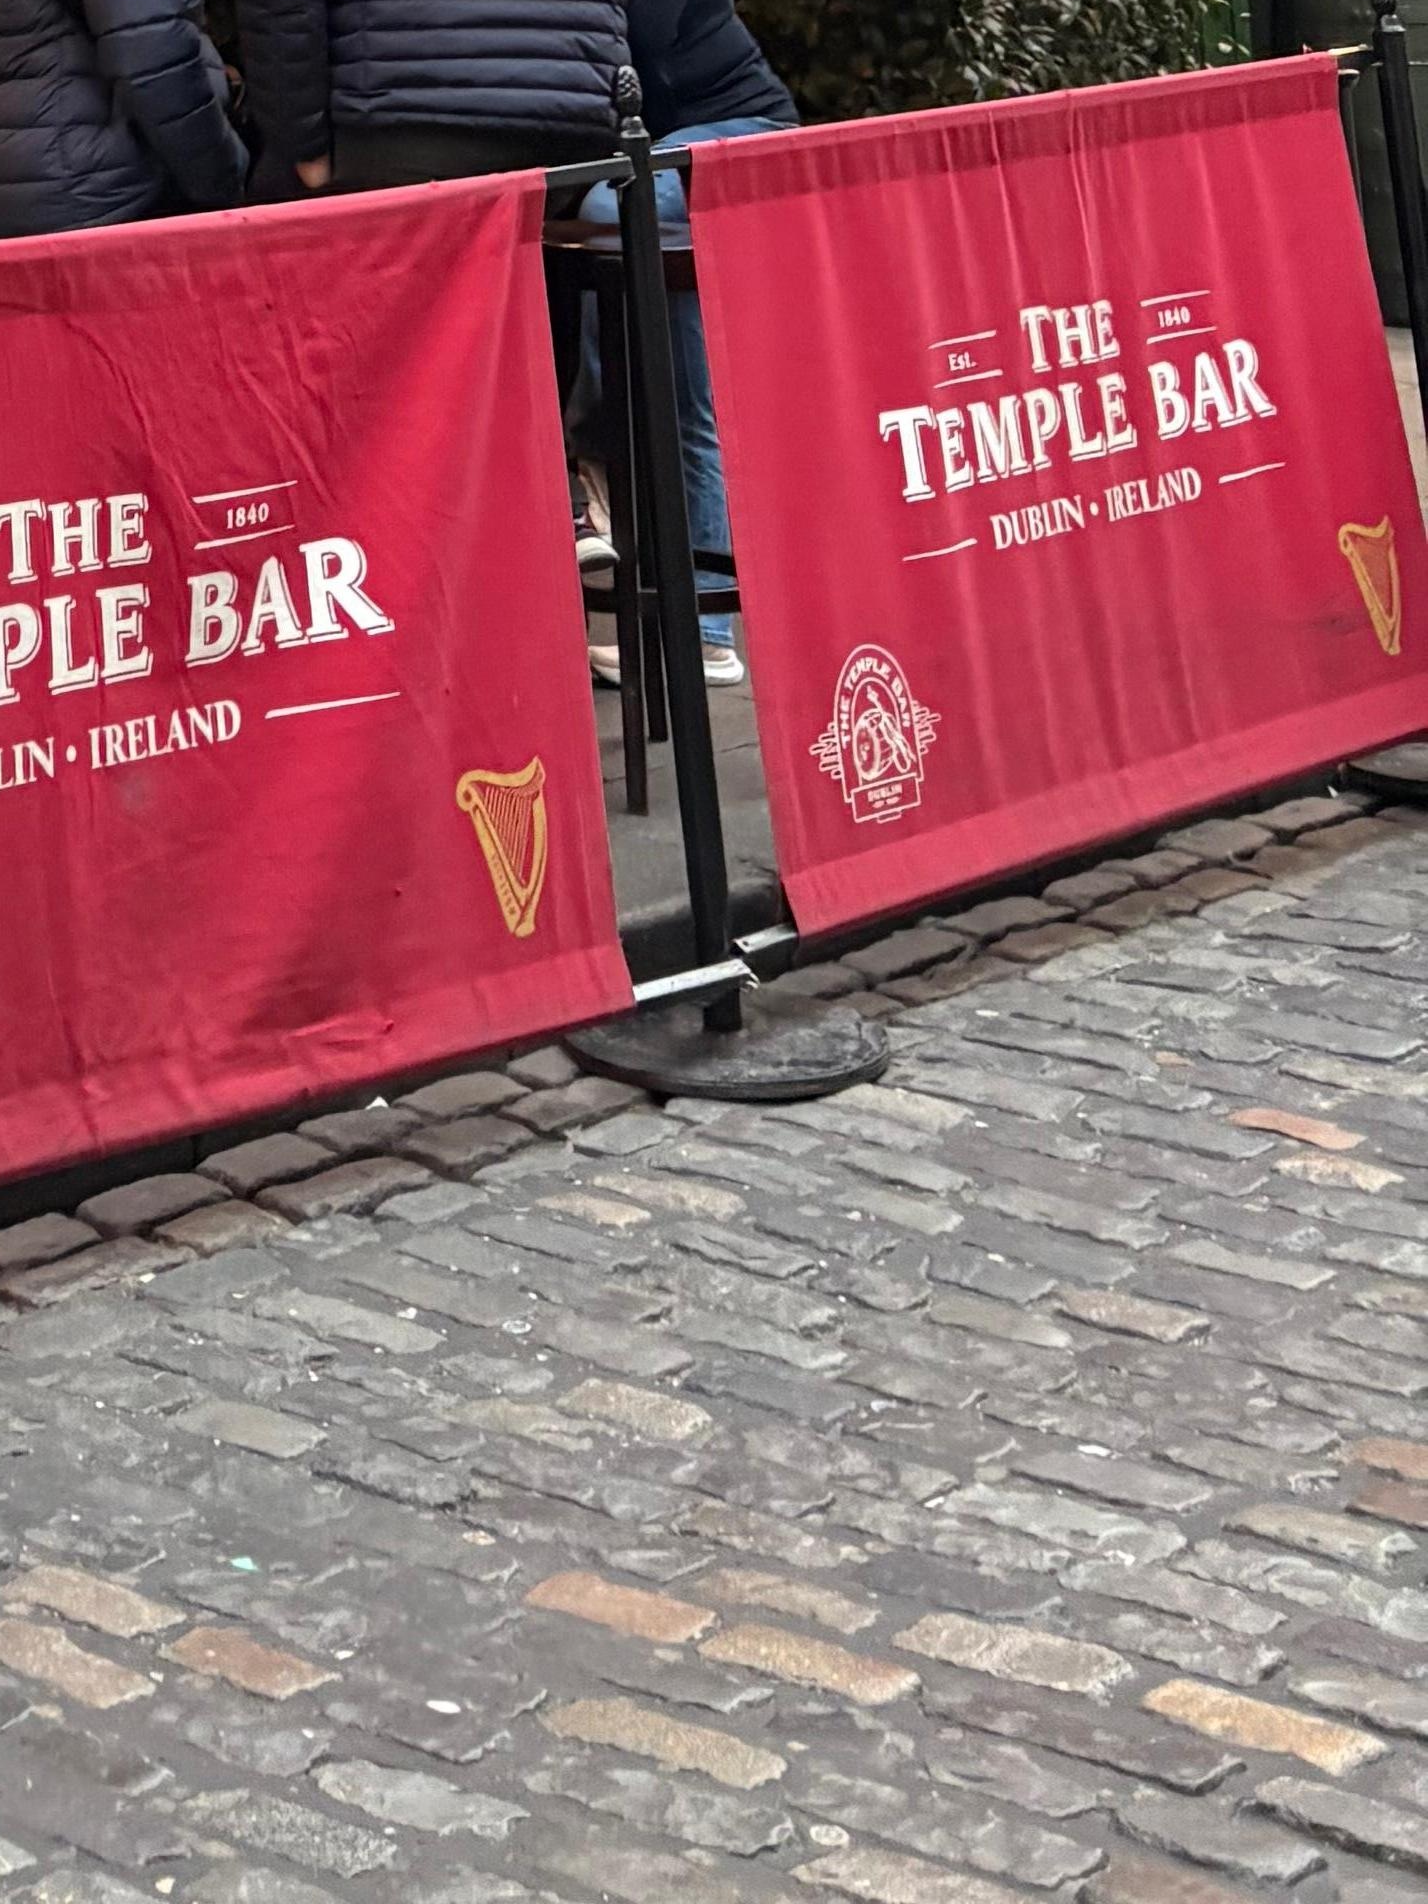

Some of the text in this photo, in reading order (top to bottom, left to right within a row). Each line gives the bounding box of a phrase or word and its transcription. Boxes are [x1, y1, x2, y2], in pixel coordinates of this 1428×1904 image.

[948, 352, 976, 371] Est.
[1020, 300, 1120, 373] THE
[879, 339, 1276, 502] TEMPLE BAR
[227, 503, 269, 528] 1840
[990, 468, 1201, 549] DUBLIN IRELAND
[185, 538, 395, 667] BAR
[89, 700, 241, 769] IRELAND
